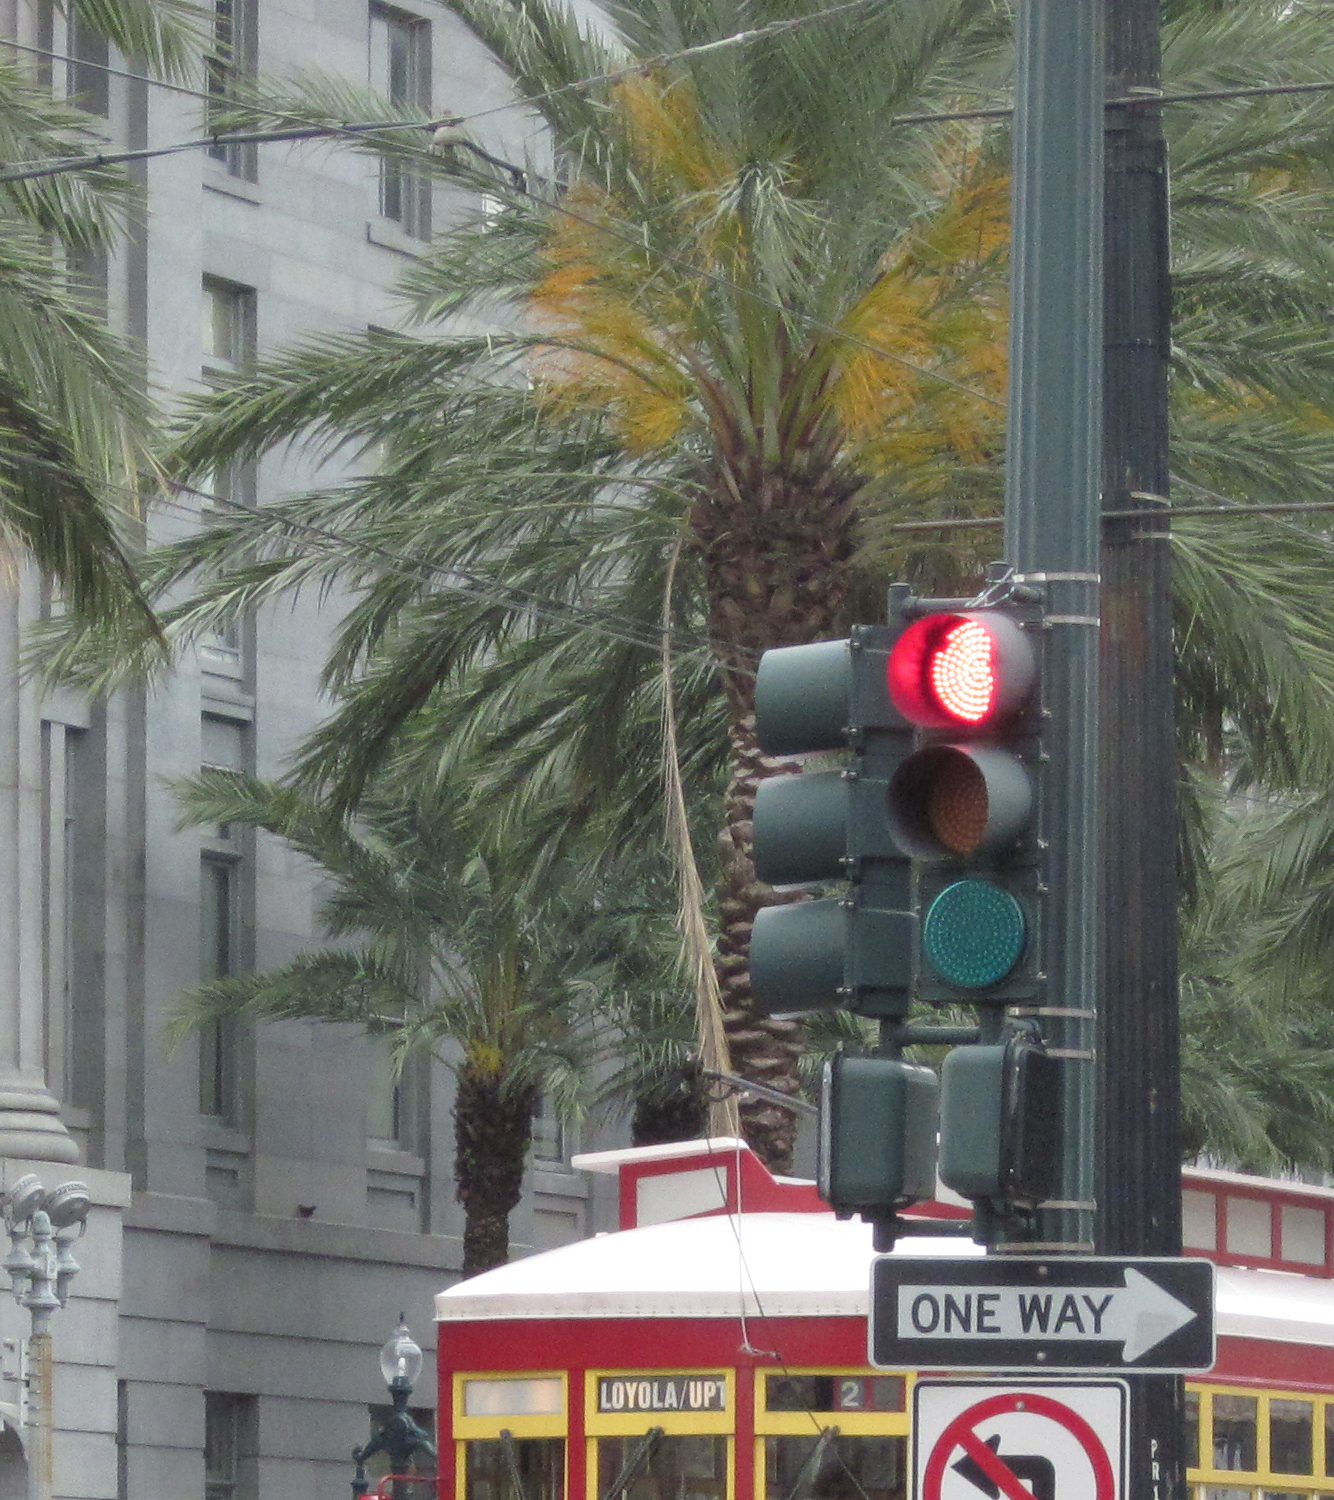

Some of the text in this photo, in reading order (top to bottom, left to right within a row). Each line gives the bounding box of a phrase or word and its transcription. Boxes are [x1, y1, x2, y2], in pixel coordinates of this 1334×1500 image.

[911, 1293, 1114, 1333] ONE WAY
[840, 1381, 860, 1408] 2
